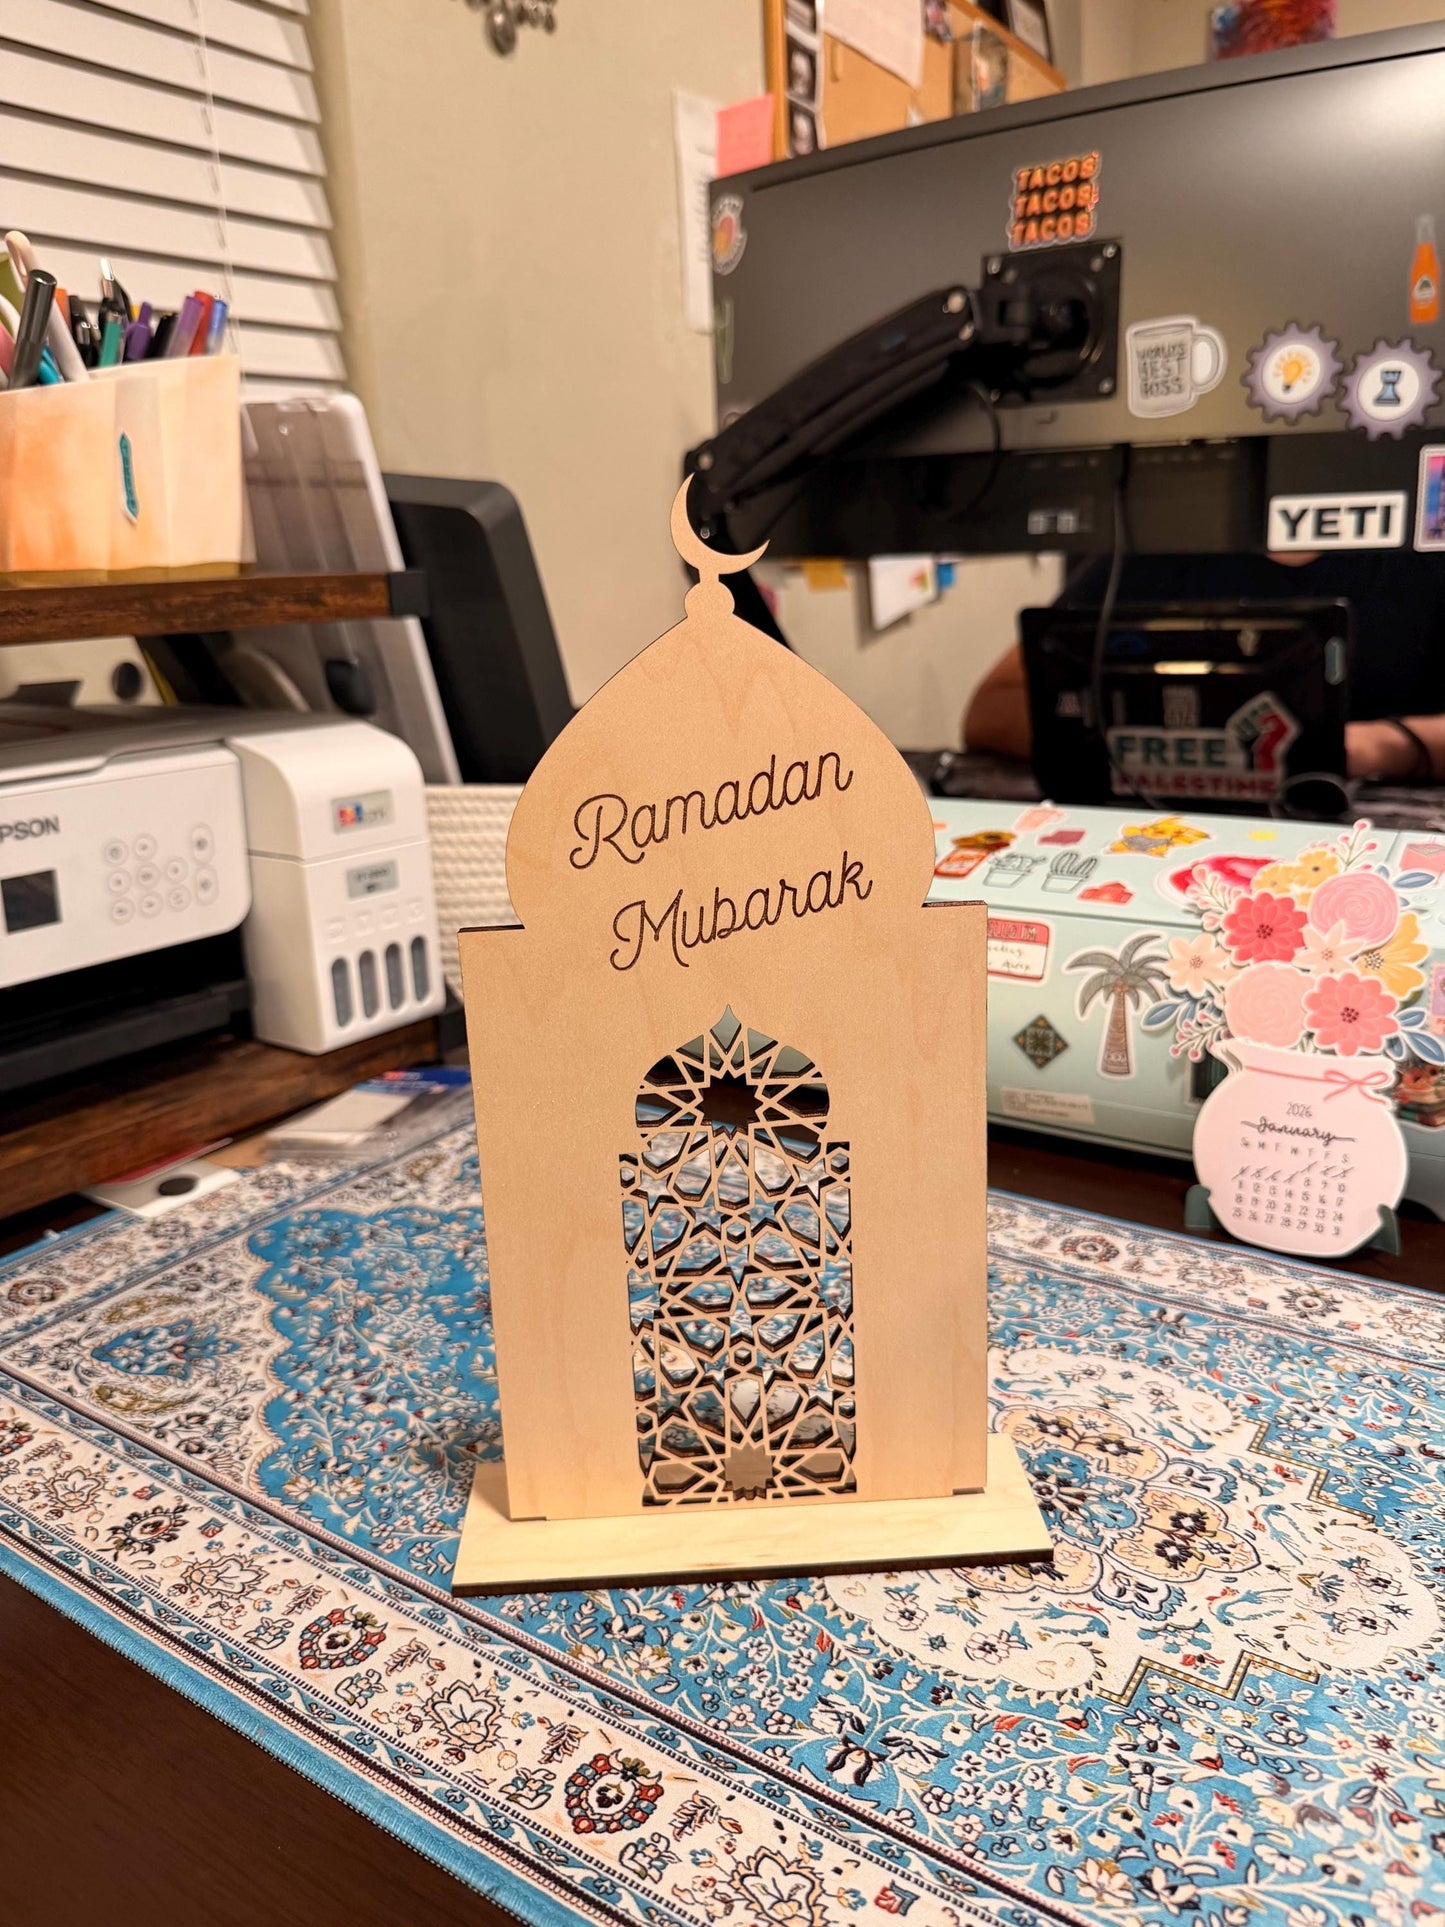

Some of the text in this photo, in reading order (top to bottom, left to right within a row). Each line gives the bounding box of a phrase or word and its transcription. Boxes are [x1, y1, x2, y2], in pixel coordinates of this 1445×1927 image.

[1016, 156, 1097, 192] TACOS
[1013, 182, 1093, 219] TACOS
[1009, 209, 1091, 247] TACOS
[1278, 505, 1396, 541] YETI
[1112, 734, 1227, 769] FREE
[1116, 771, 1277, 797] PALESTINE
[569, 751, 854, 870] Ramadan
[0, 815, 60, 843] PSON
[609, 850, 873, 970] Mubarak
[1285, 1102, 1313, 1119] 2026
[1241, 1116, 1355, 1147] January
